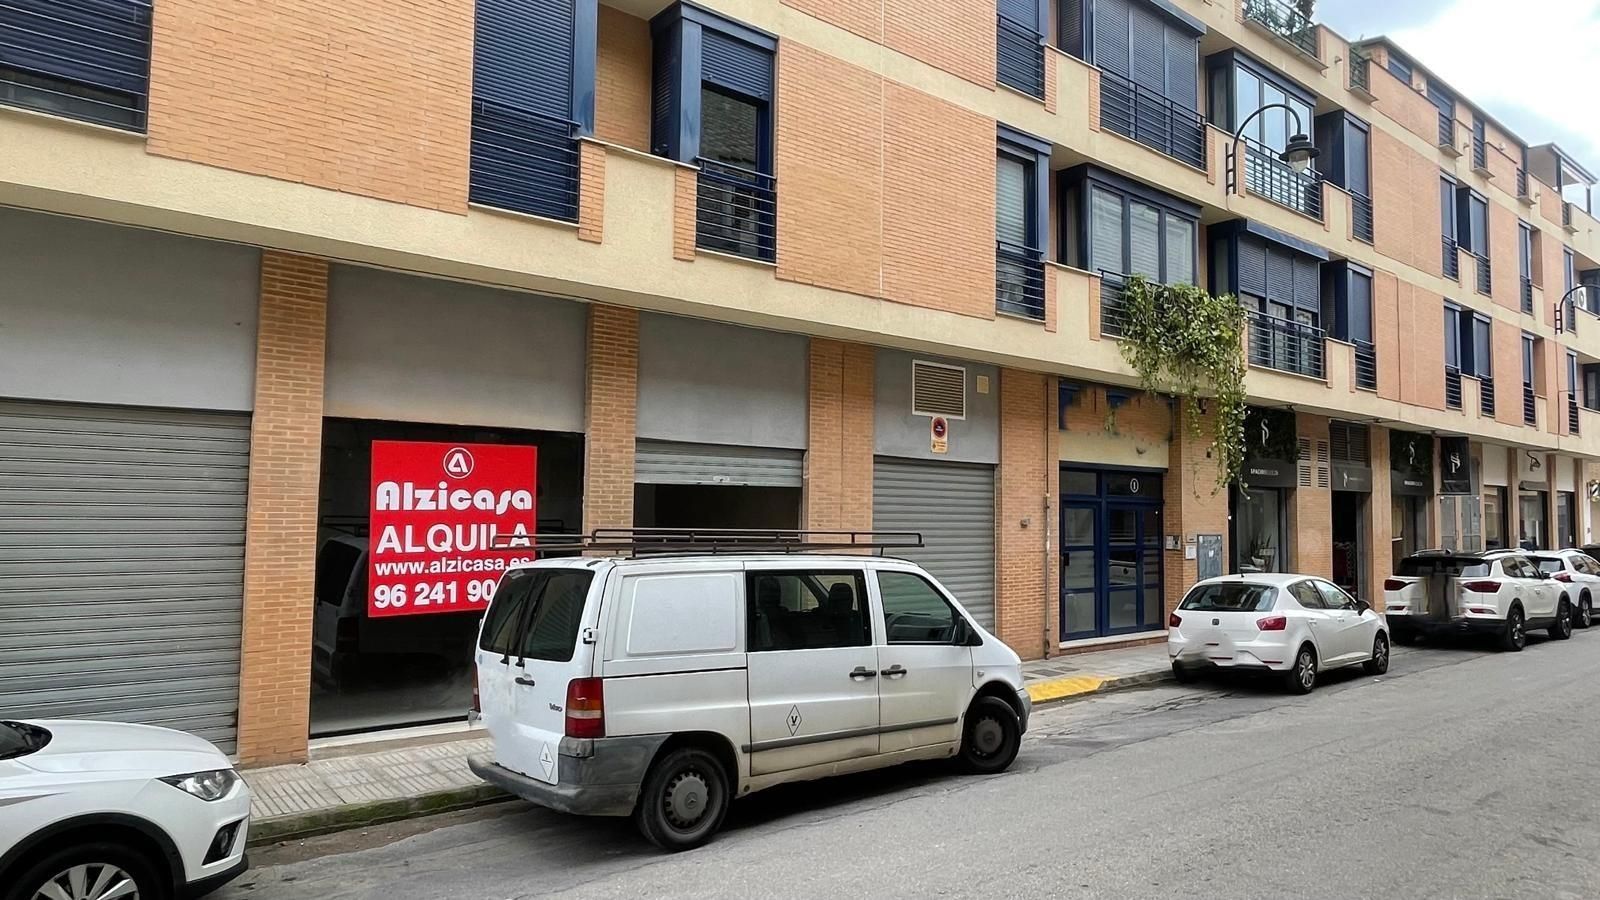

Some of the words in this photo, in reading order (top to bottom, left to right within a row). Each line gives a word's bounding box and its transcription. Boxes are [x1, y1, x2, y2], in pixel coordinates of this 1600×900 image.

[376, 481, 533, 515] Alzicasa
[376, 523, 531, 554] ALQUILA
[375, 556, 530, 576] www.alzicasa.es
[374, 583, 407, 609] 96
[414, 581, 457, 606] 241
[467, 579, 496, 602] 90
